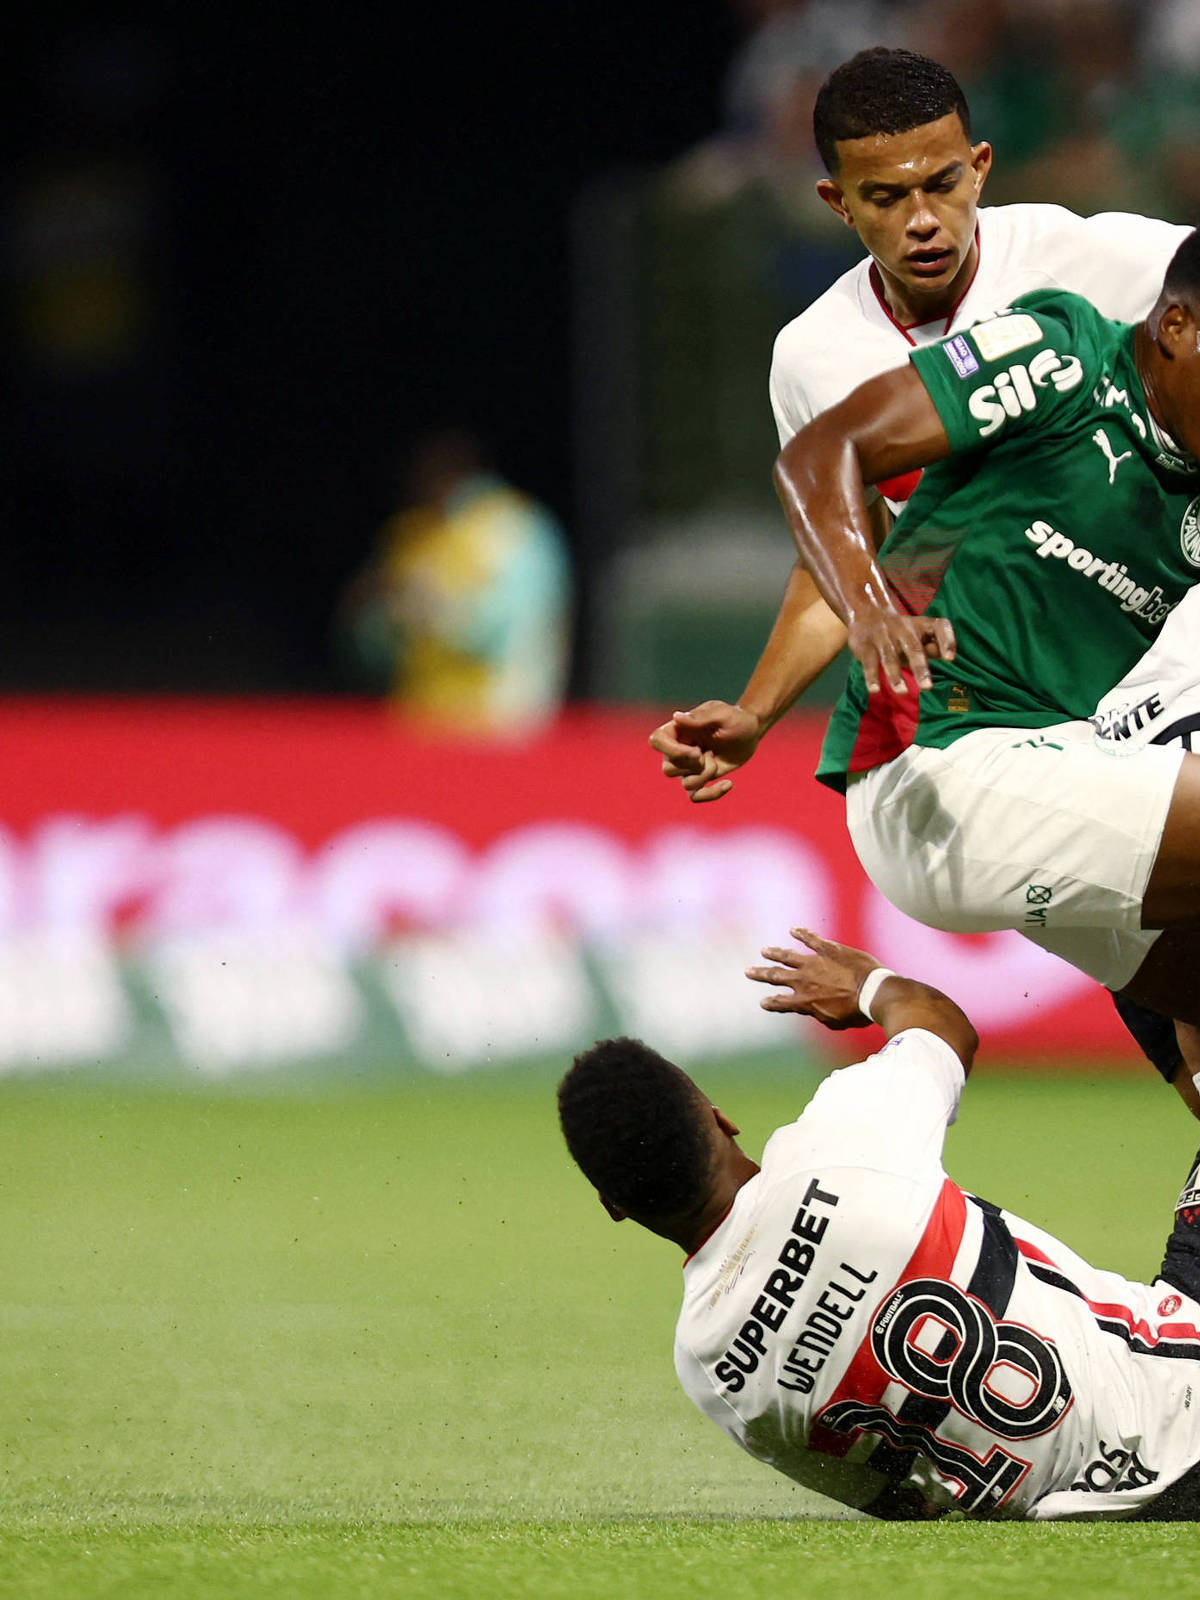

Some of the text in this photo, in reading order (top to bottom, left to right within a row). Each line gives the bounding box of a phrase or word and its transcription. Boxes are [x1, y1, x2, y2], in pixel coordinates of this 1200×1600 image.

[715, 1178, 840, 1393] SUPERBET
[777, 1262, 878, 1395] WENDELL
[810, 1277, 1075, 1512] 18
